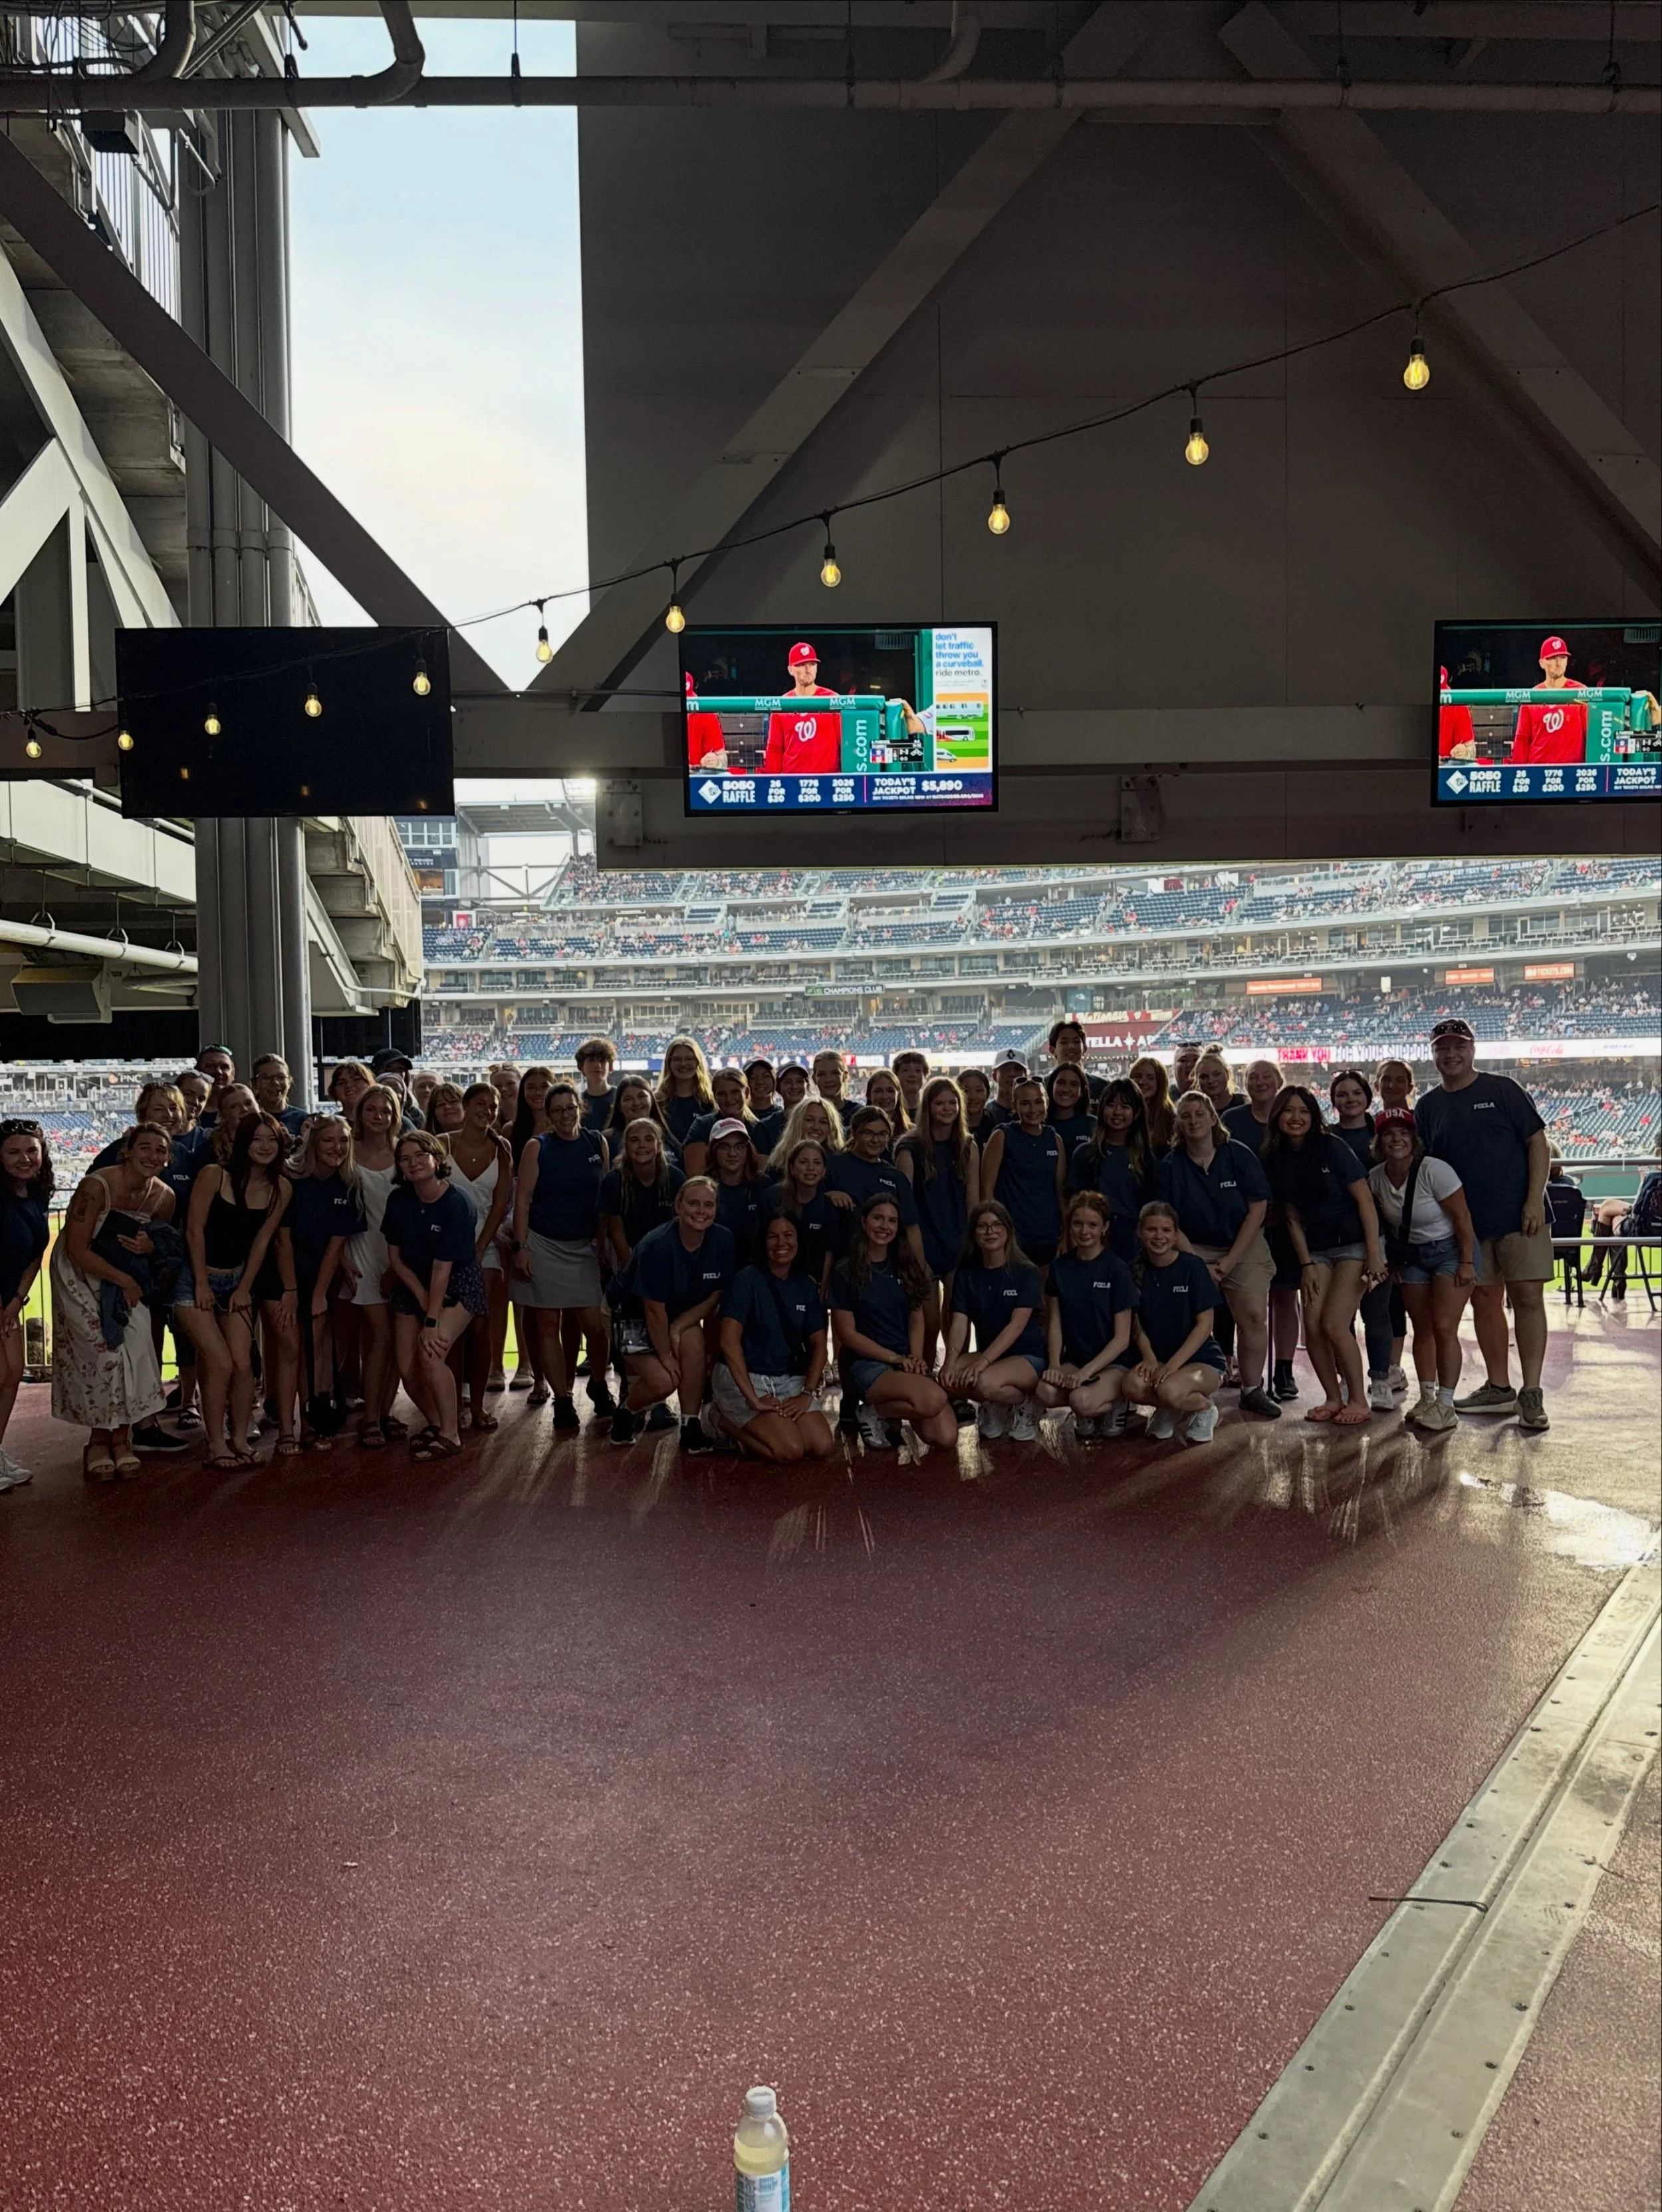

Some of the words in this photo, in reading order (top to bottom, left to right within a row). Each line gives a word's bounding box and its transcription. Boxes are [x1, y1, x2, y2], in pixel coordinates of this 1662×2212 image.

[1506, 691, 1531, 699] MGM
[1578, 689, 1603, 698] MGM
[755, 699, 780, 707] MGM
[1542, 709, 1564, 734] W
[794, 717, 816, 742] W
[1469, 771, 1502, 781] 5050
[1576, 768, 1597, 777] 2026
[1616, 767, 1657, 776] TODAY'S
[723, 780, 756, 790] 5050
[832, 778, 855, 787] 2026
[874, 778, 916, 786] TODAY'S
[1613, 776, 1657, 785] JACKPOT
[872, 786, 916, 796] JACKPOT
[921, 780, 963, 792] $5,890
[1469, 781, 1501, 793] RAFFLE
[723, 790, 756, 803] RAFFLE
[798, 794, 821, 803] $200
[1087, 1036, 1122, 1048] TELLA
[1312, 1047, 1331, 1063] YOU
[1336, 1046, 1354, 1061] FOR
[1357, 1046, 1384, 1061] YOUR
[1387, 1044, 1433, 1061] SUPPOR
[120, 1074, 142, 1083] PNC
[1473, 1101, 1496, 1111] FCCLA
[1385, 1108, 1405, 1119] USA
